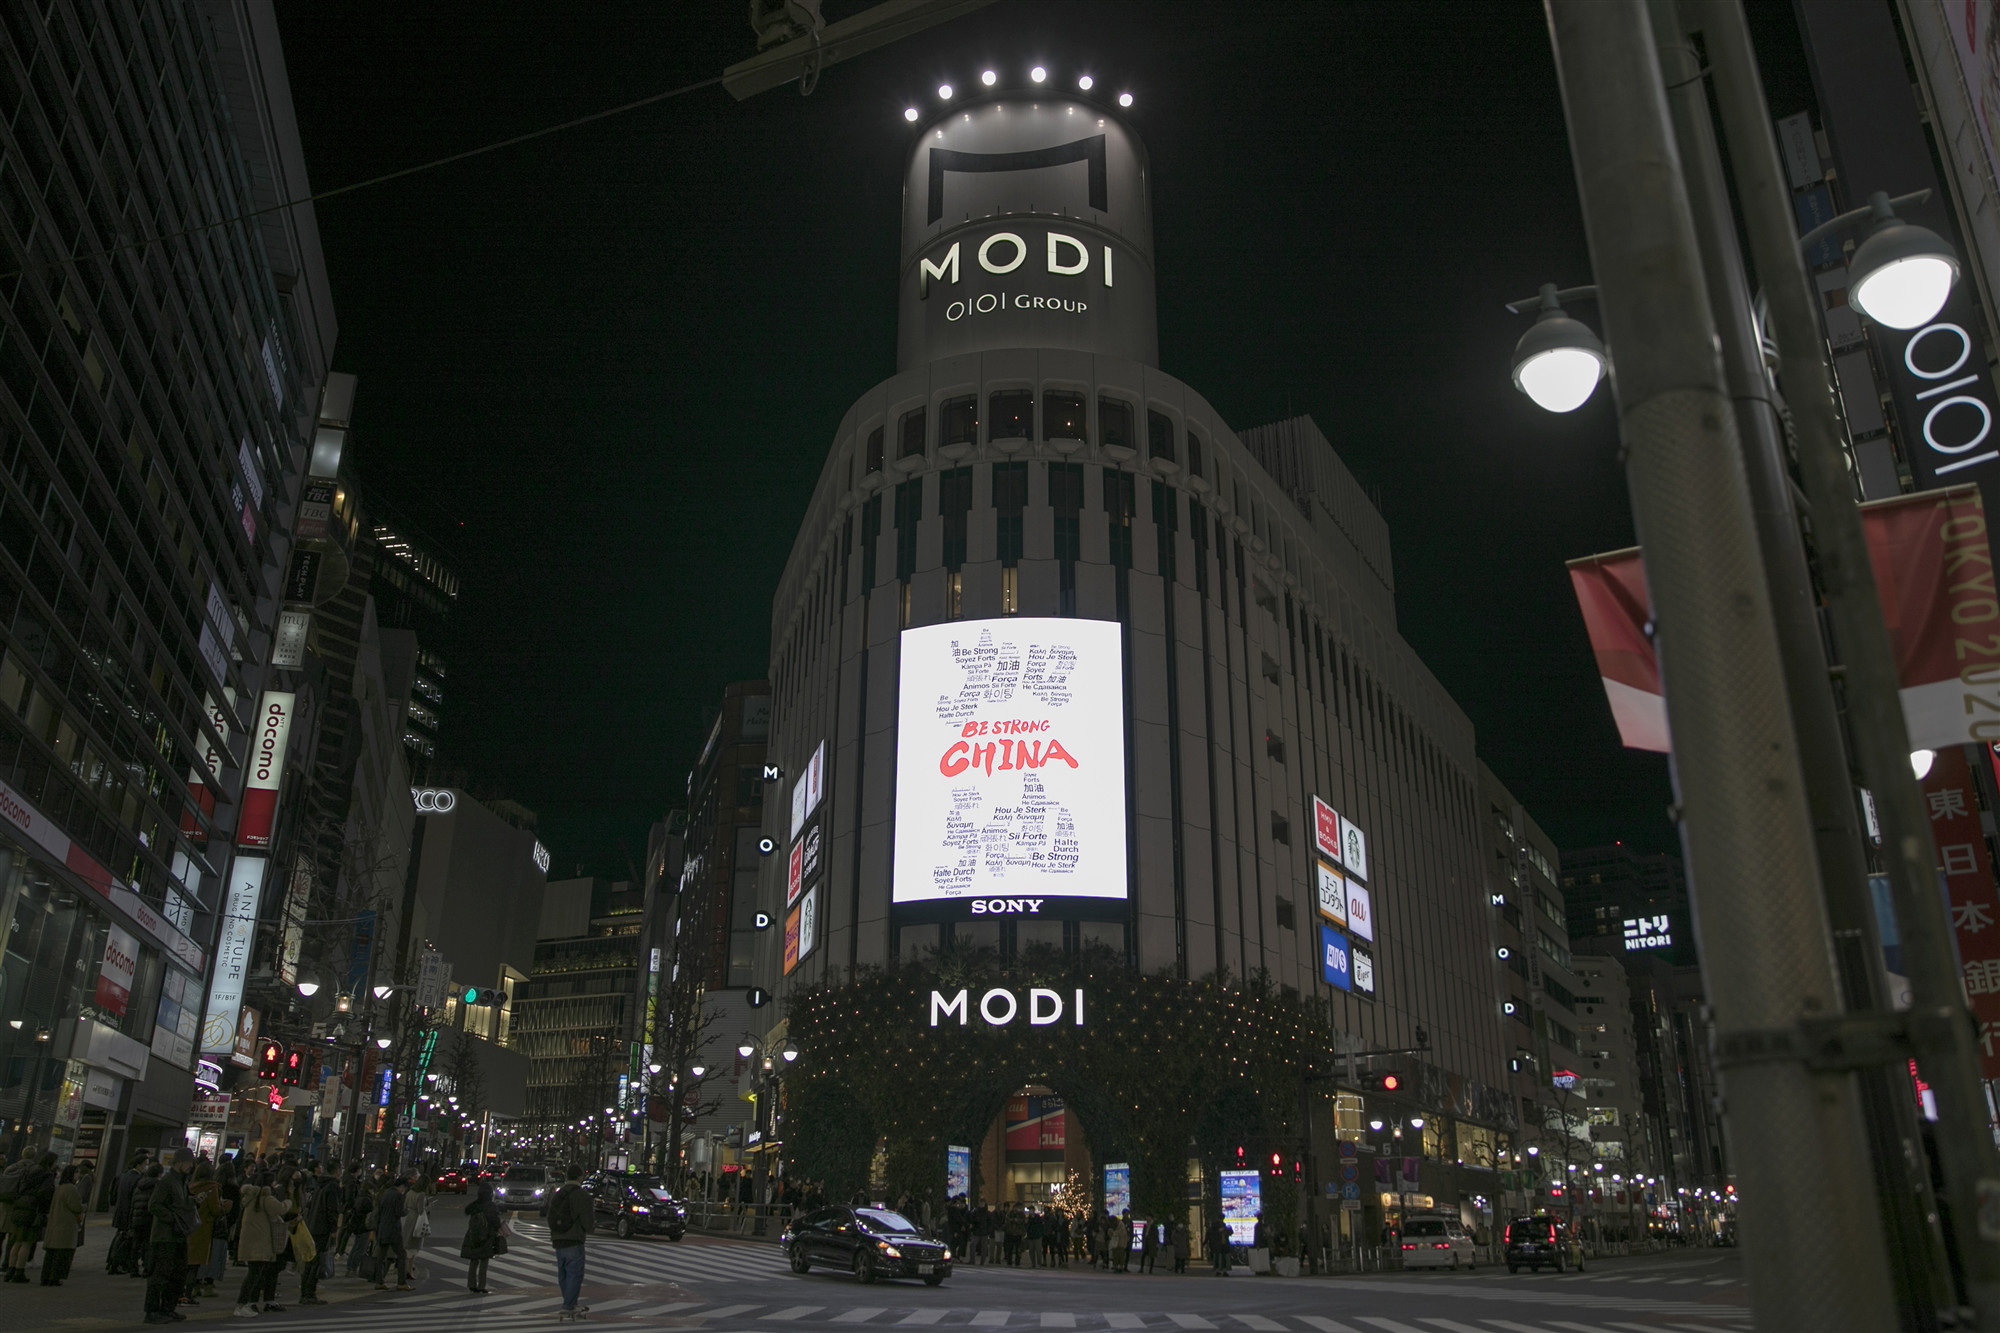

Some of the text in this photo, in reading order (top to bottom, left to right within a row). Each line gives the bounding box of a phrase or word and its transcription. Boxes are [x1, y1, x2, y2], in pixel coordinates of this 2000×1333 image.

[920, 232, 1112, 300] MODI
[1014, 294, 1087, 313] GROUP
[307, 492, 330, 503] TBC
[303, 507, 327, 518] TBC
[1936, 490, 1999, 625] TOKYO
[962, 648, 971, 656] Be
[974, 648, 998, 656] Strong
[996, 660, 1020, 671] 加油
[961, 720, 988, 737] BE
[992, 719, 1050, 734] STRONG
[257, 703, 286, 781] docomo
[940, 739, 1078, 778] CHINA
[995, 806, 1046, 814] Hou Je Sterk
[1008, 832, 1048, 840] Sii Forte
[1054, 838, 1078, 846] Halte
[1318, 830, 1338, 850] BOOKS
[1032, 852, 1045, 860] Be
[1048, 852, 1078, 863] Strong
[933, 868, 975, 877] Halte Durch
[239, 882, 254, 922] AINZ
[972, 900, 1043, 914] SONY
[1351, 898, 1367, 922] au
[137, 907, 157, 931] docomo
[1624, 914, 1669, 937] ニトリ
[1625, 934, 1671, 950] NITORI
[106, 940, 135, 977] docomo
[228, 937, 246, 980] TULPE
[930, 988, 1084, 1026] MODI
